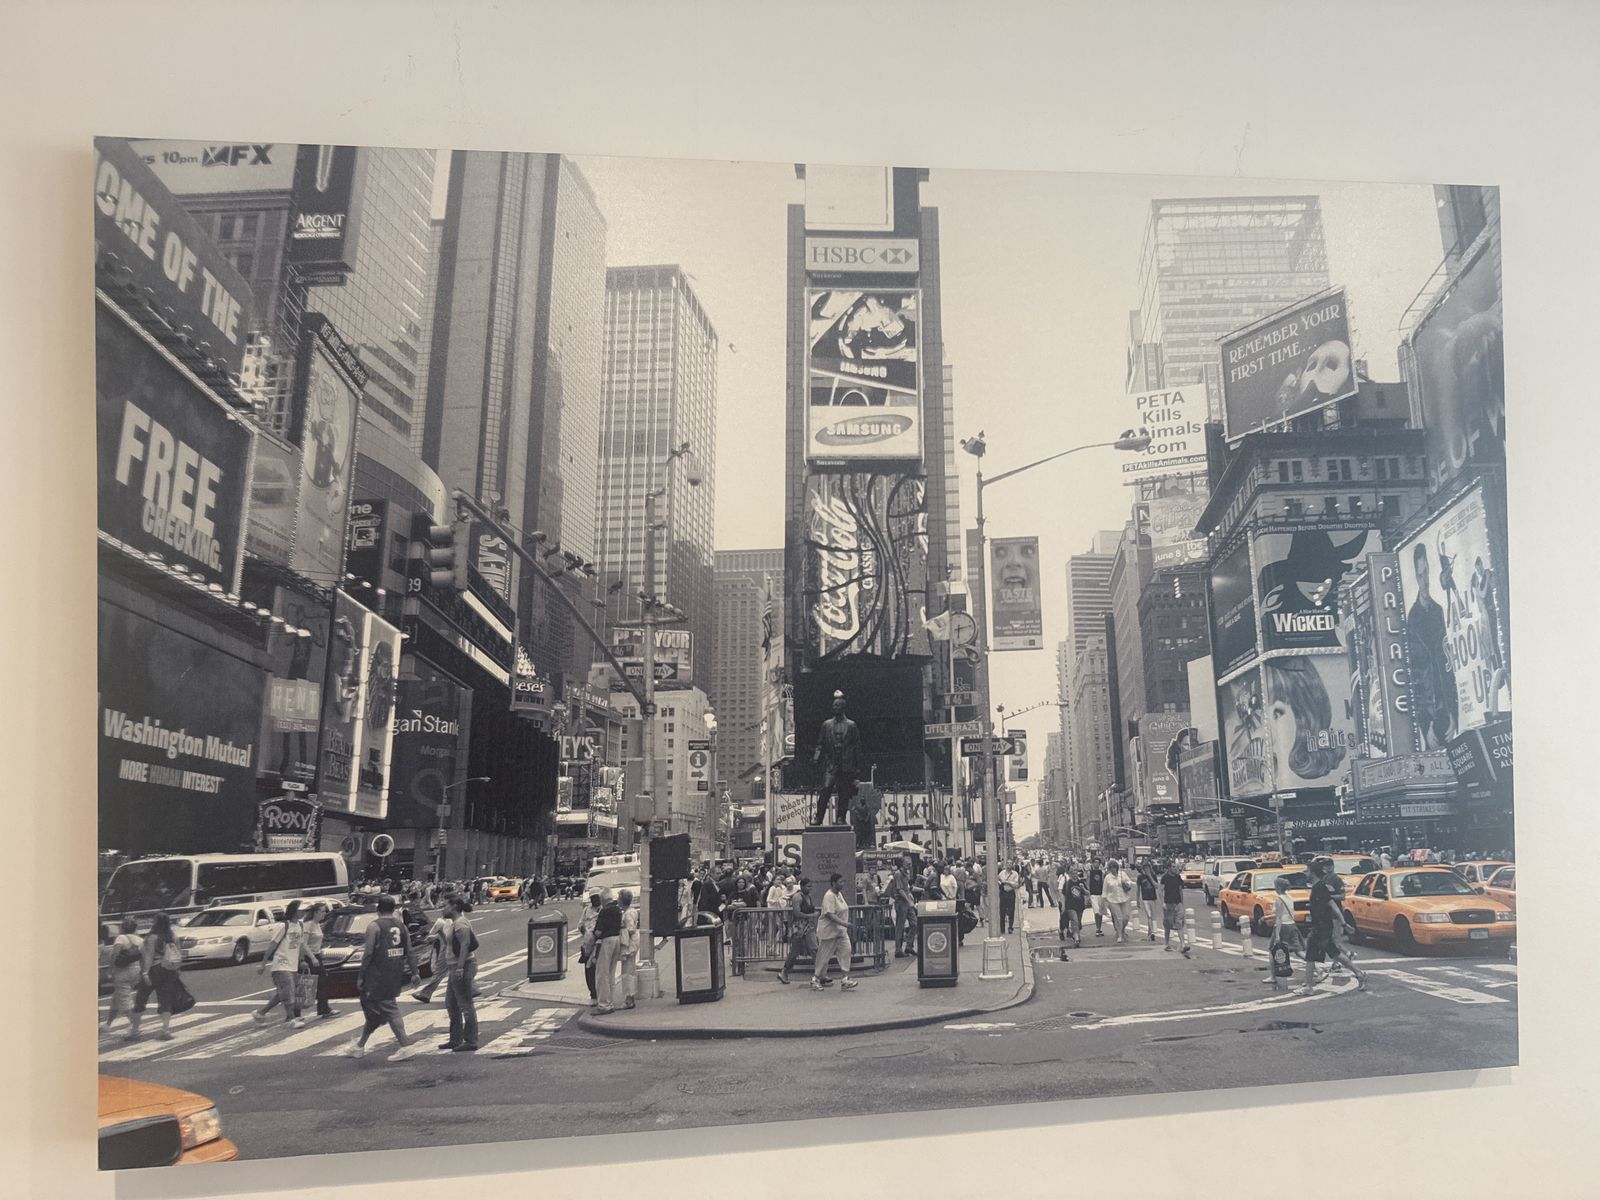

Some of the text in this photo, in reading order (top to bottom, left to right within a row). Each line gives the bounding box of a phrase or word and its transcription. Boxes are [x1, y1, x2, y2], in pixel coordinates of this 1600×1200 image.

[163, 151, 199, 164] 10pm
[296, 213, 345, 229] ARGENT
[811, 247, 876, 264] HSBC
[163, 232, 198, 293] OF
[200, 267, 241, 345] THE
[1229, 304, 1340, 364] REMEMBER YOUR
[1231, 356, 1265, 383] FIRST
[1137, 391, 1185, 410] PETA
[1143, 408, 1182, 425] Kills
[827, 423, 902, 436] SAMSUNG
[115, 400, 222, 538] FREE
[479, 535, 507, 598] HEY'S
[1000, 587, 1034, 600] TASTE
[654, 631, 690, 648] YOUR
[1381, 566, 1409, 712] PALACE
[515, 681, 546, 692] ese's
[104, 708, 252, 768] Washington Mutual
[924, 723, 979, 735] LITTLE BRAZIL
[558, 736, 594, 759] EY'S
[1451, 742, 1469, 758] TIMES
[119, 759, 148, 783] MORE
[390, 926, 401, 946] 3
